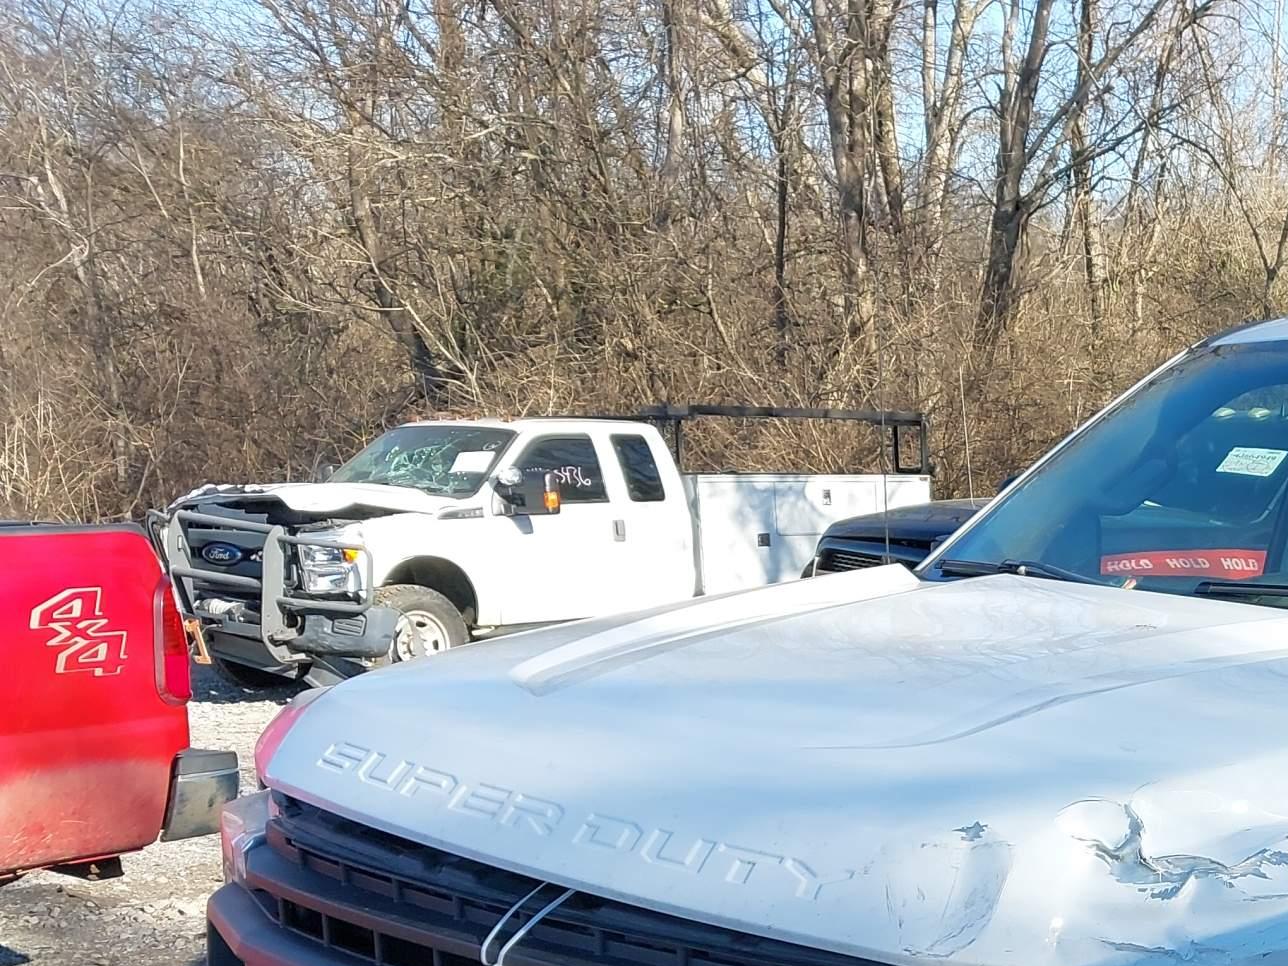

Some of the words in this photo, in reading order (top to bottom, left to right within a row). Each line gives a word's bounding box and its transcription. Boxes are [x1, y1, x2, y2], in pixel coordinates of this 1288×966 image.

[208, 547, 230, 560] Ford
[1106, 558, 1154, 573] HOLD
[1165, 557, 1210, 570] HOLD
[1220, 557, 1259, 571] HOLD
[316, 740, 566, 837] SUPER
[571, 812, 855, 901] DUTY
